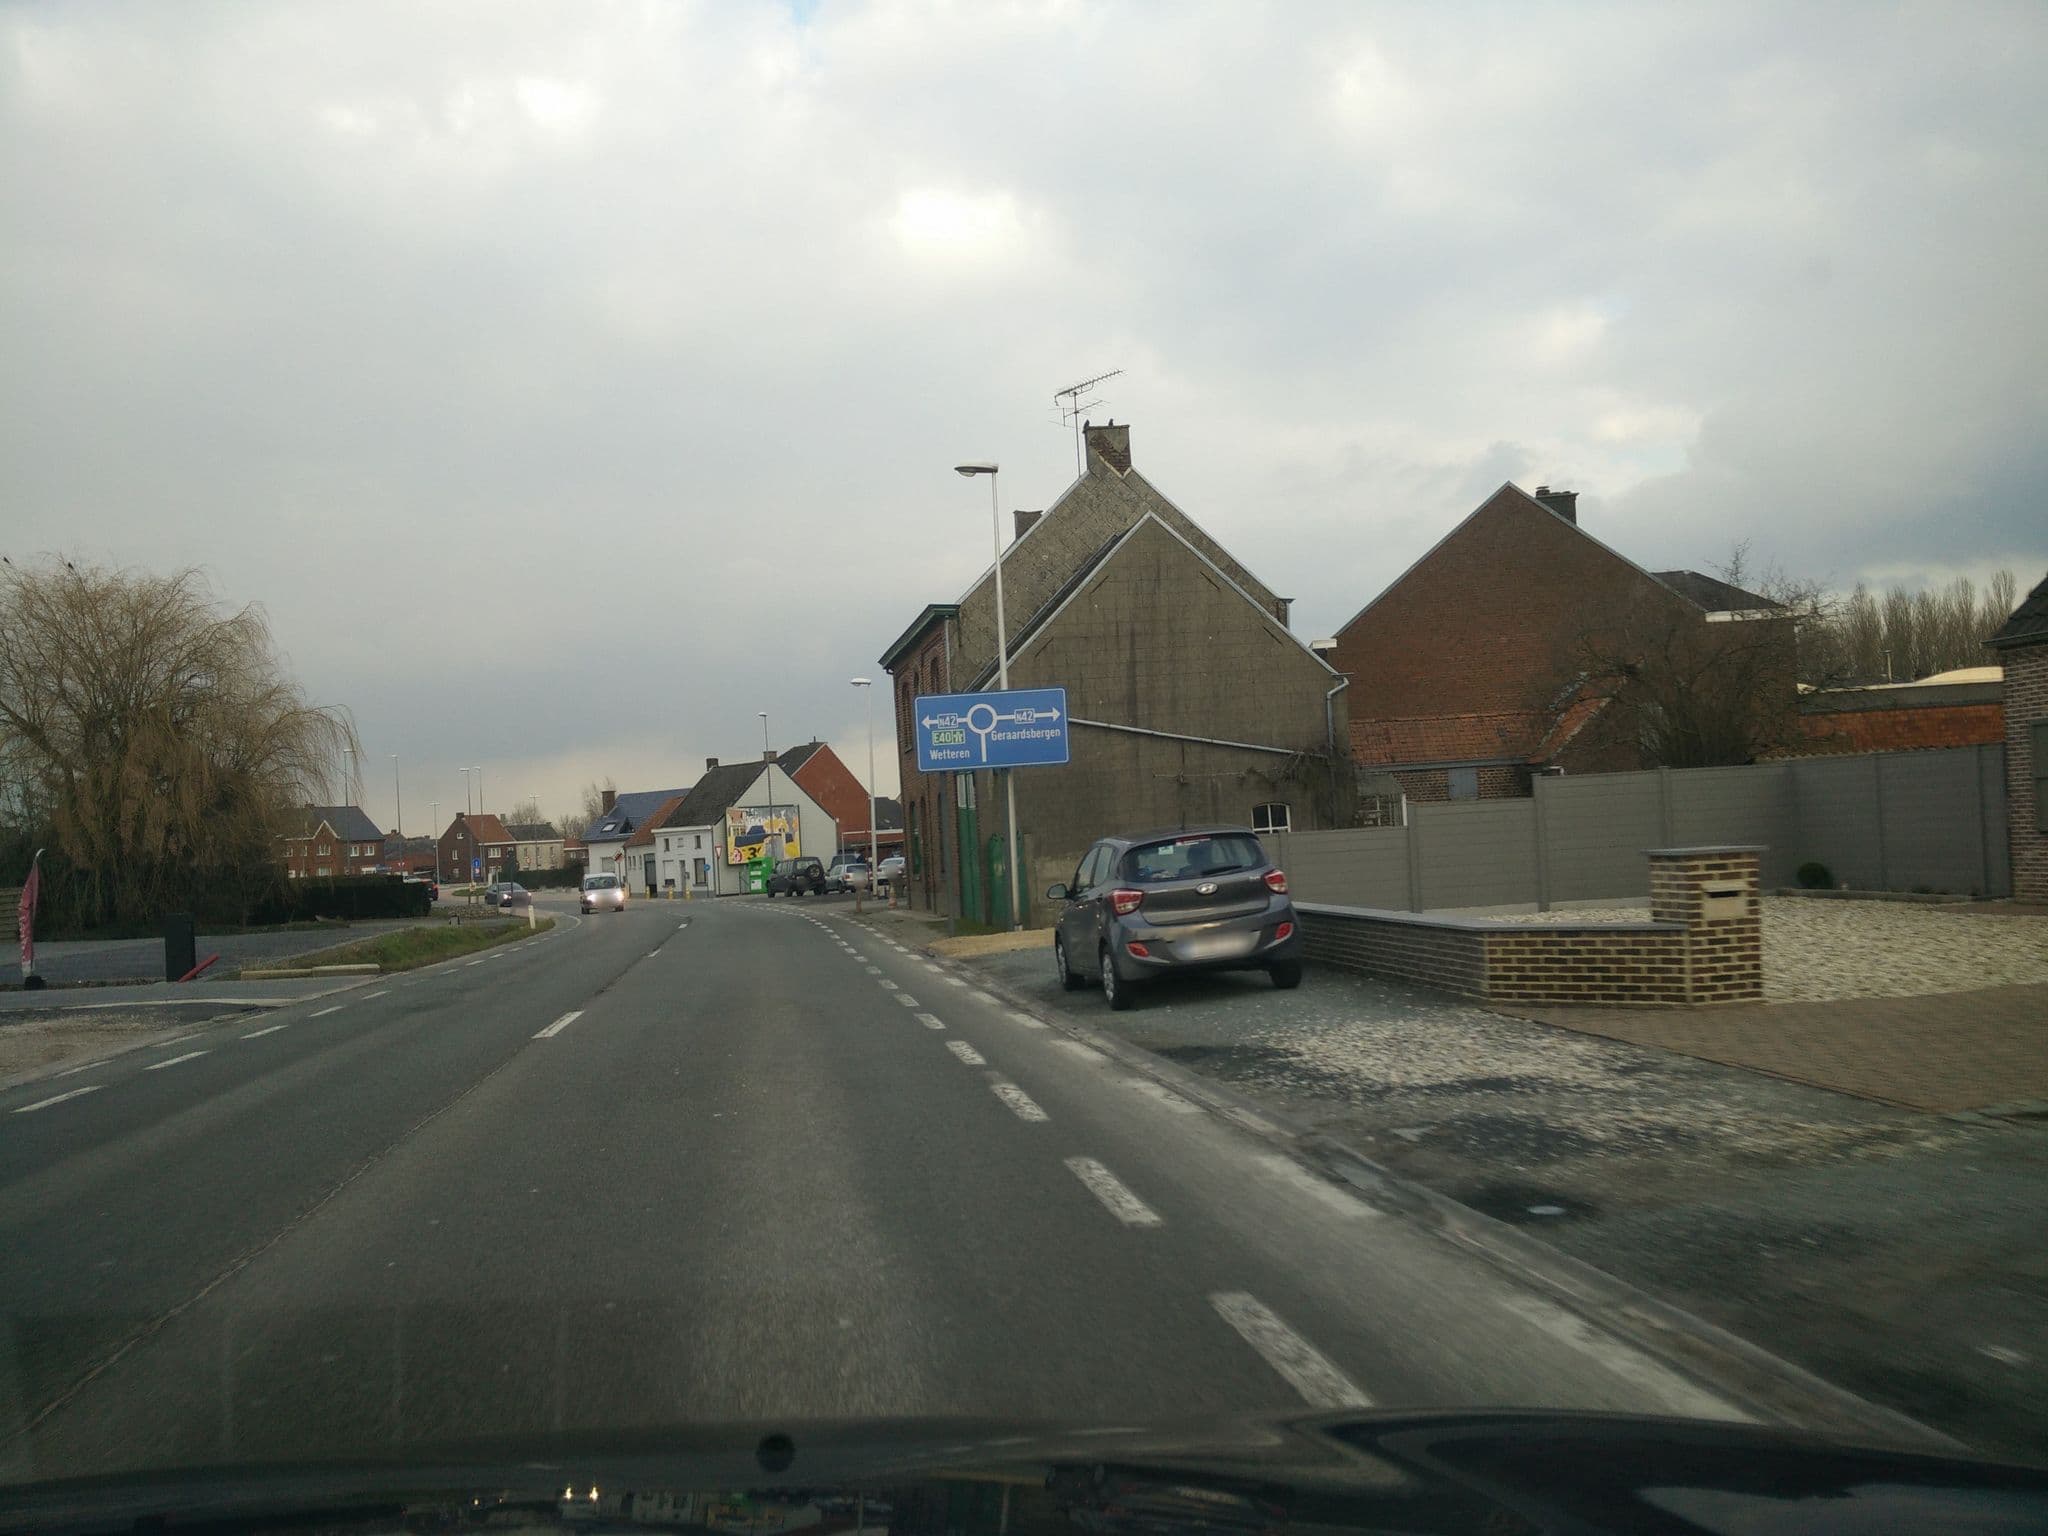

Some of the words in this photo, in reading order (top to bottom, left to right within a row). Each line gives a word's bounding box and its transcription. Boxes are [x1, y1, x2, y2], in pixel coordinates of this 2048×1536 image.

[939, 716, 956, 727] N42
[1016, 711, 1033, 722] N42
[933, 731, 951, 743] E40
[991, 728, 1061, 741] Geraardsbergen
[930, 749, 970, 760] Wetteren
